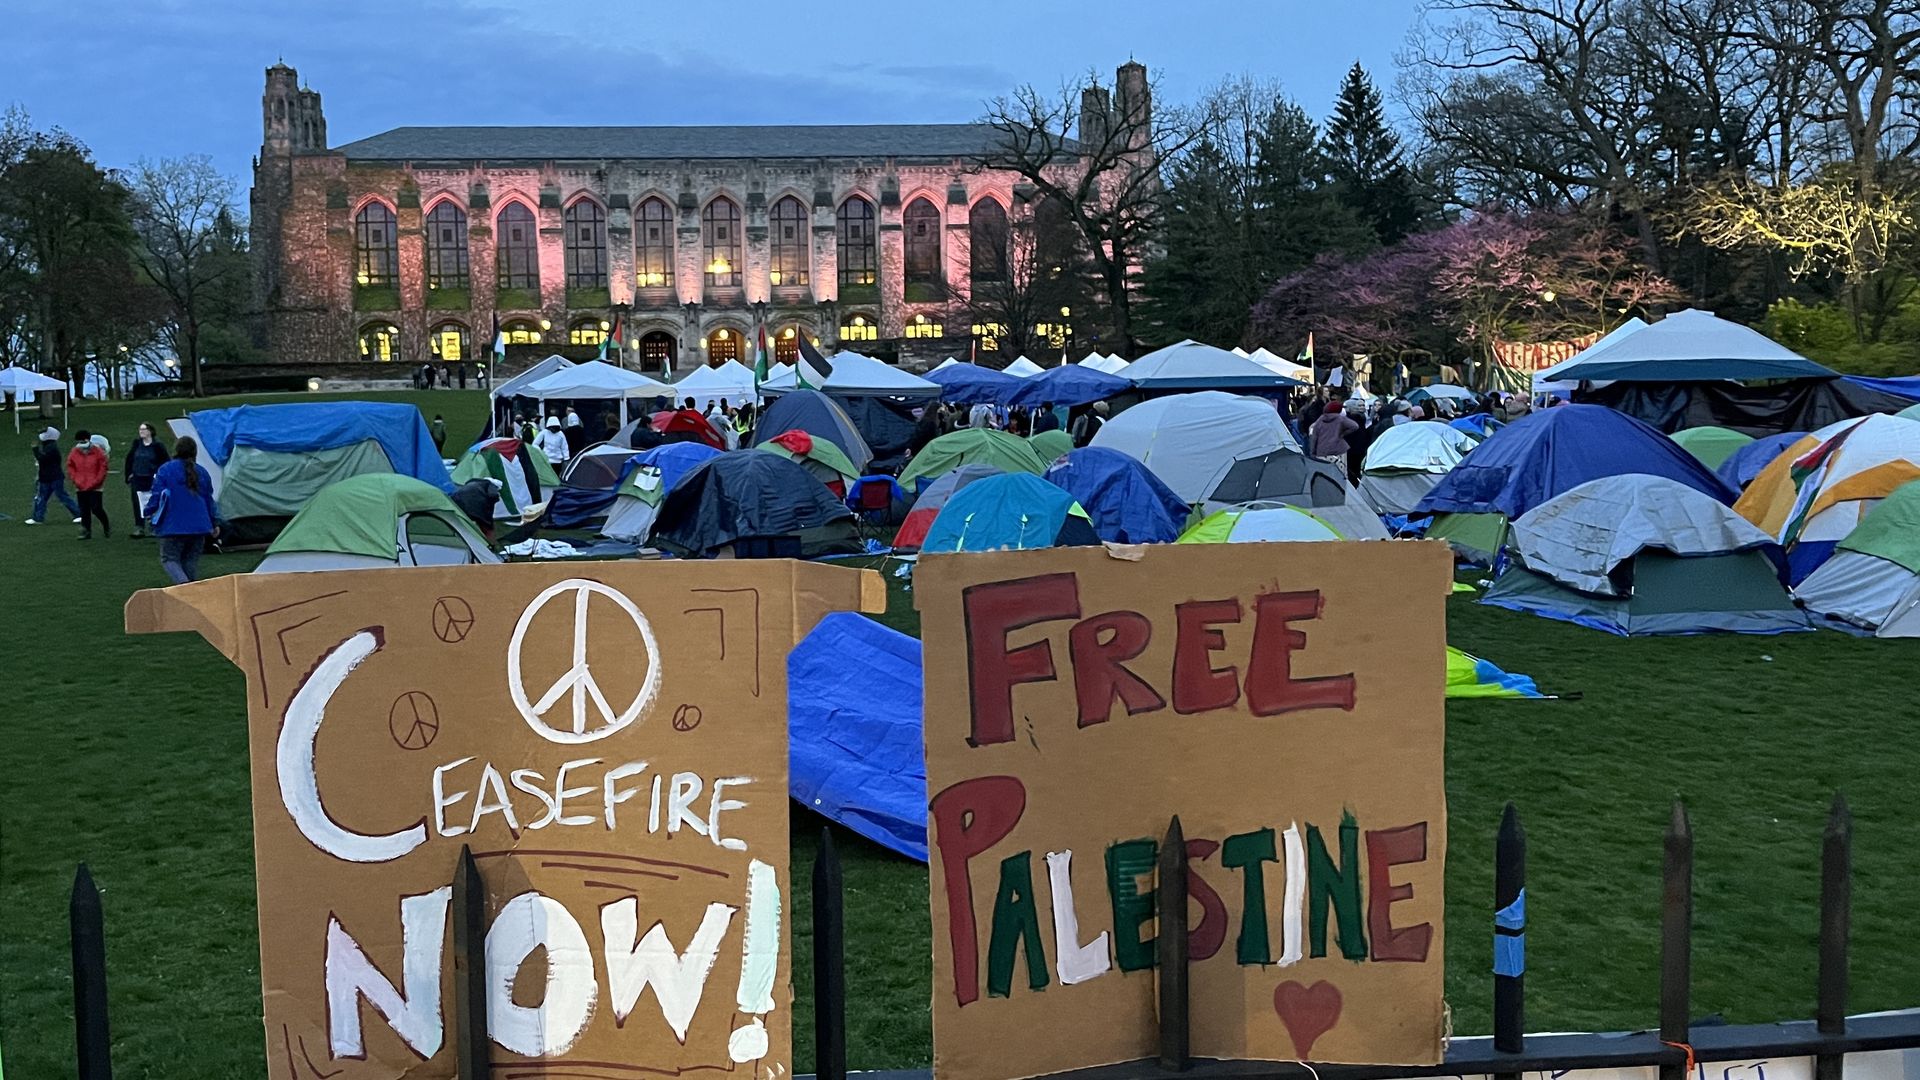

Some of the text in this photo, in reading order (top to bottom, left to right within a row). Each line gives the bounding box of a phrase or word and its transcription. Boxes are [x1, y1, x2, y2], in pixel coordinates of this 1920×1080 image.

[1523, 333, 1597, 369] PALESTIN
[277, 625, 758, 863] CEASEFIRE
[962, 572, 1357, 748] FREE
[323, 858, 782, 1064] NOW!
[928, 774, 1433, 1007] PALESTINE
